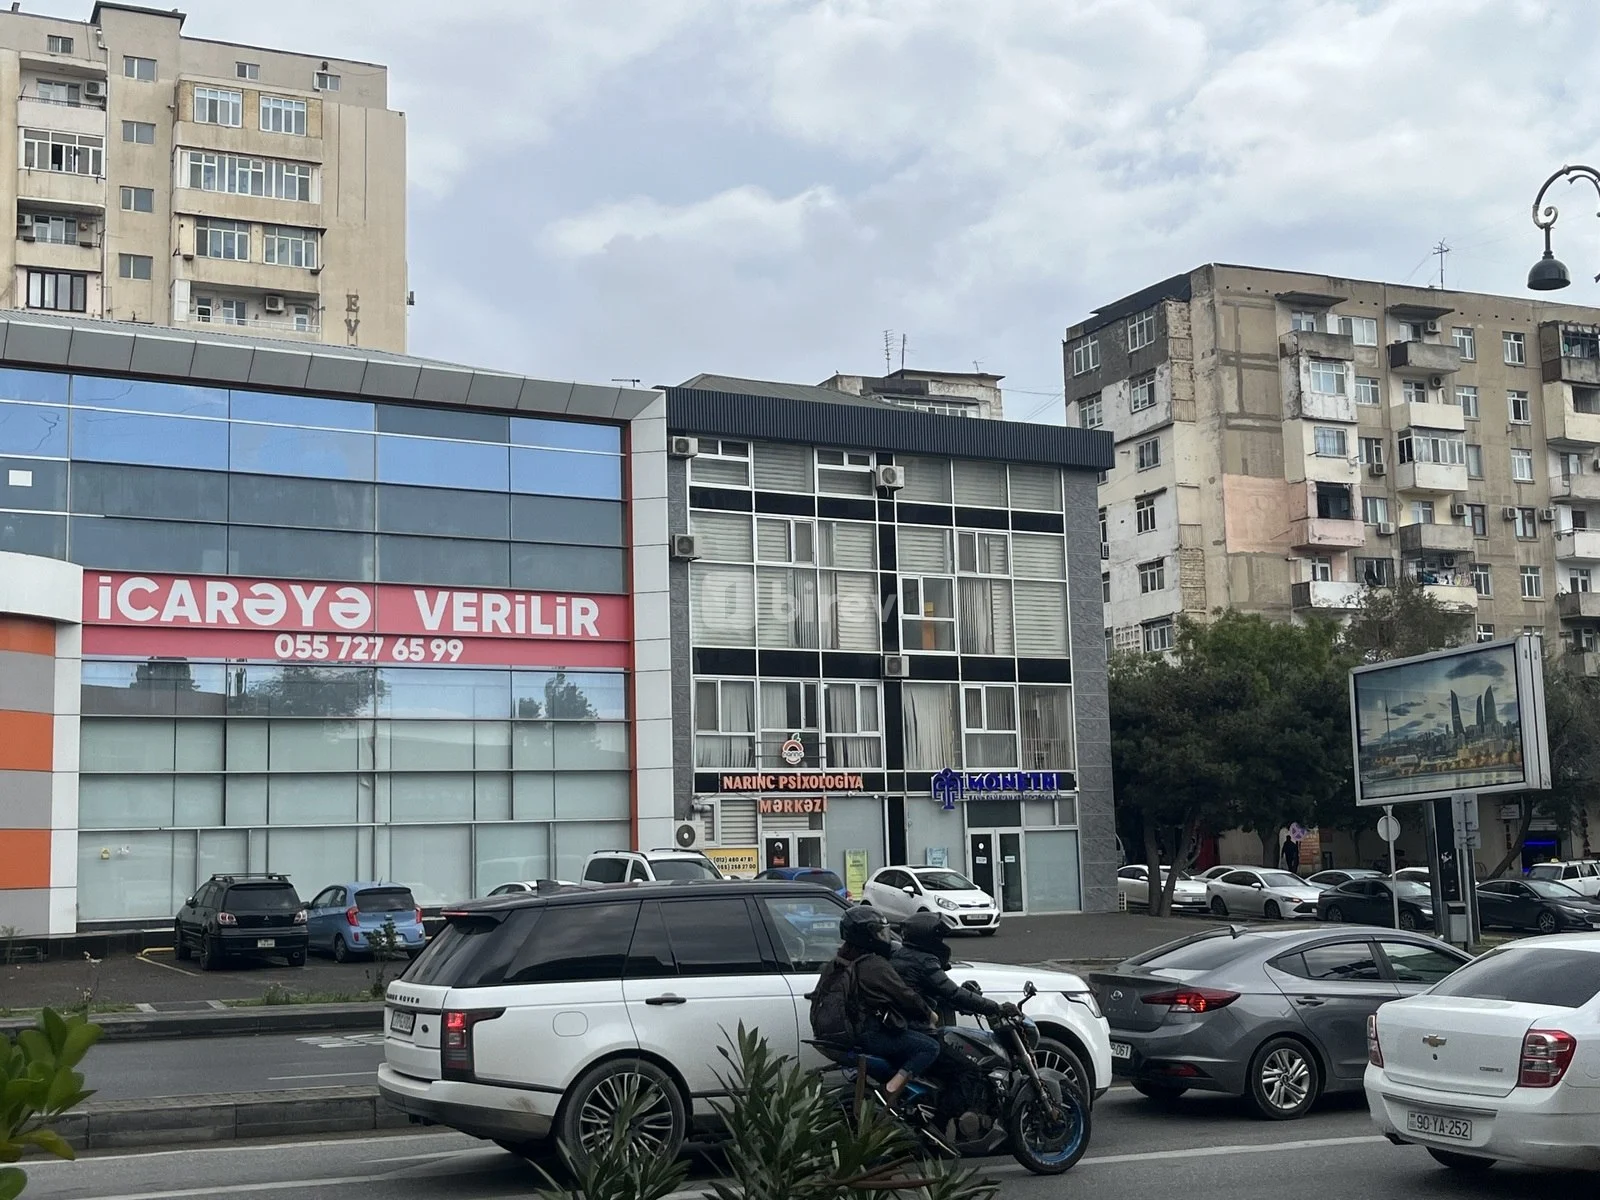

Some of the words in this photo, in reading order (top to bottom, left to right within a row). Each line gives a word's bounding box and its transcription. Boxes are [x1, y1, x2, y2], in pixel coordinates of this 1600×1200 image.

[274, 633, 330, 660] 055
[335, 636, 385, 660] 727
[391, 637, 426, 662] 65
[430, 638, 464, 662] 99
[723, 775, 776, 790] NARINC
[778, 772, 864, 789] PSİXOLOGİYA
[759, 795, 828, 813] MƏRKƏZİ
